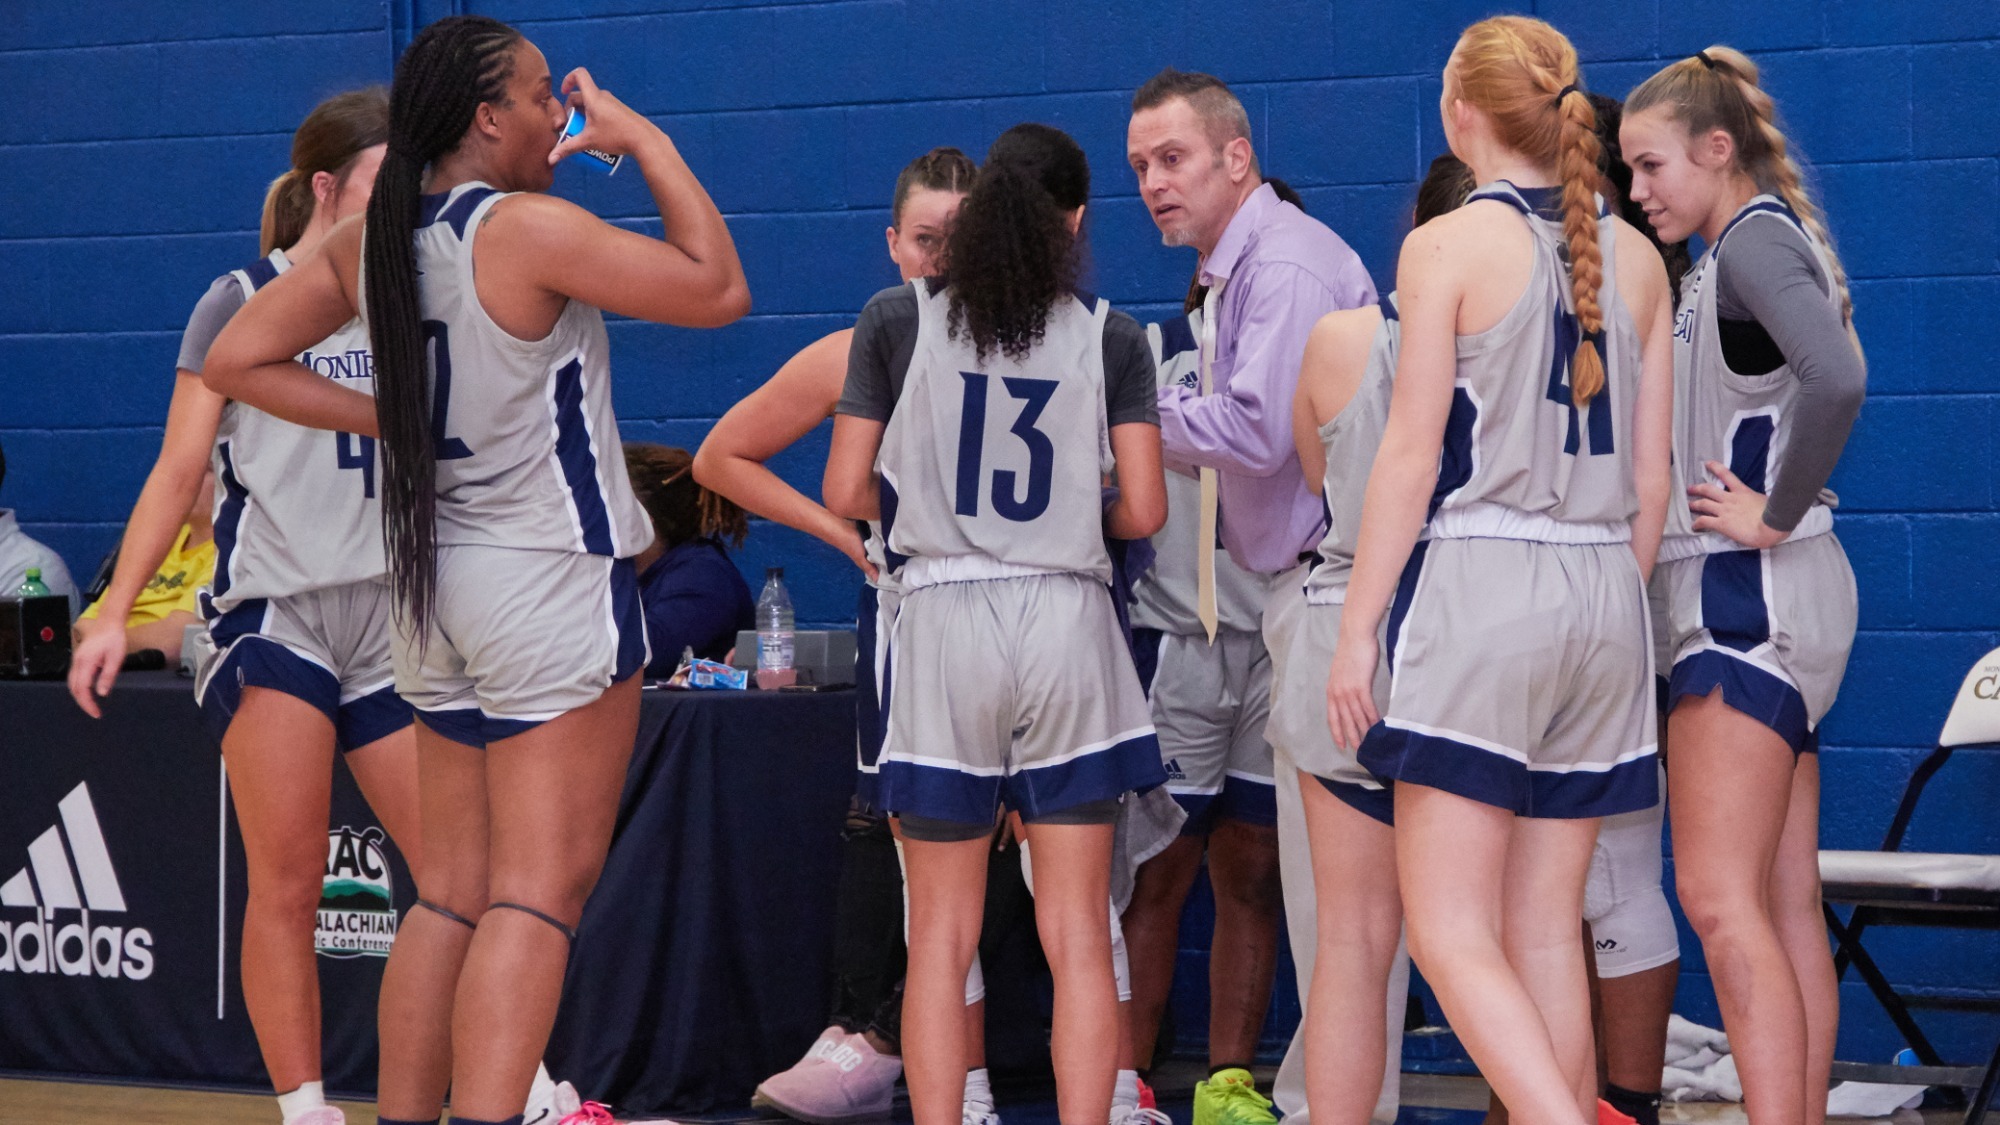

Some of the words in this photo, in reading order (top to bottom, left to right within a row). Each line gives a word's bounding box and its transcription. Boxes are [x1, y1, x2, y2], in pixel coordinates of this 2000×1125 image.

[955, 371, 1060, 522] 13
[326, 827, 384, 880] AC
[0, 906, 154, 980] adidas
